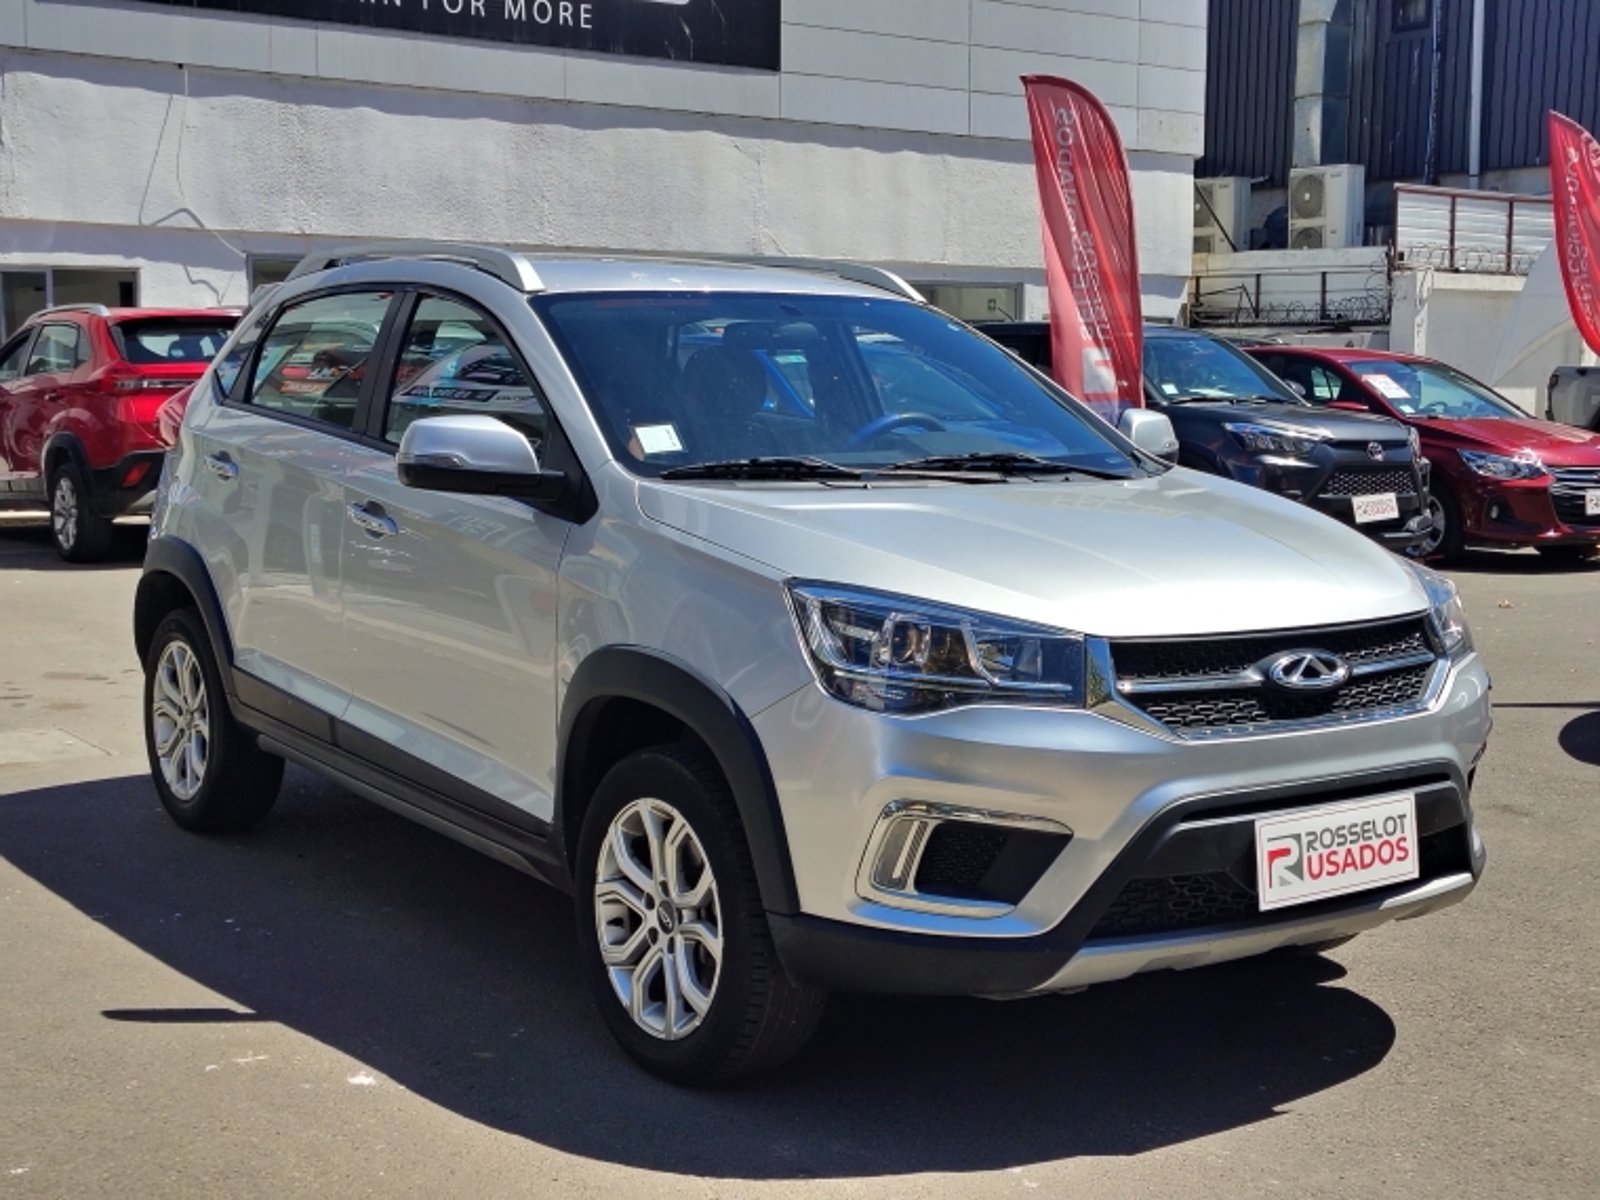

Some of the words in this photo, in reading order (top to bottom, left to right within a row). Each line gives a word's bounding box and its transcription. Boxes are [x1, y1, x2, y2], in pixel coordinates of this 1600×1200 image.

[504, 0, 592, 28] MORE
[1305, 814, 1407, 852] ROSSELOT
[1306, 836, 1410, 880] USADOS
